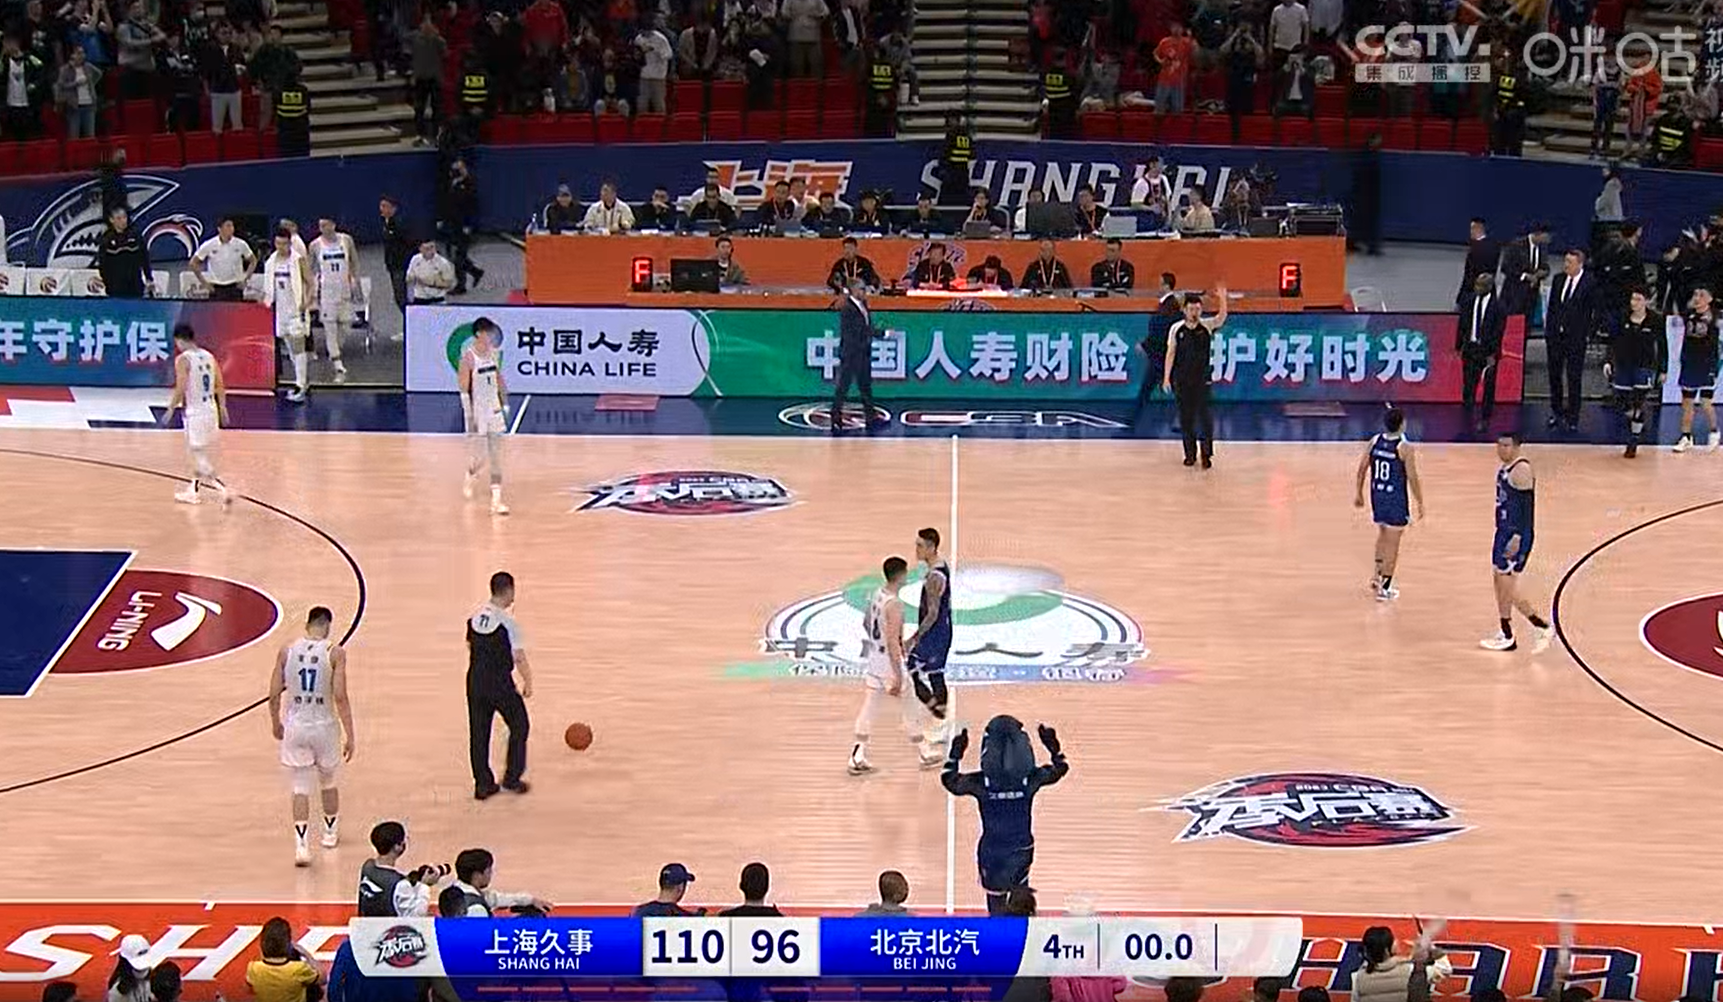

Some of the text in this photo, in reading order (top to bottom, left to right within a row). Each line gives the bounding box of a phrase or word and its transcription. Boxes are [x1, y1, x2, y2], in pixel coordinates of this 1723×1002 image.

[920, 158, 1231, 207] SHANGAI
[634, 259, 650, 283] F
[1282, 265, 1297, 290] F
[0, 319, 170, 362] 年守护保
[517, 326, 660, 357] 中国人寿
[517, 361, 657, 377] CHINA LIFE
[1210, 332, 1429, 382] 护好时光
[1374, 459, 1390, 481] 18
[97, 590, 163, 651] LI-NING
[764, 637, 1147, 671] 中人寿
[298, 667, 317, 692] 17
